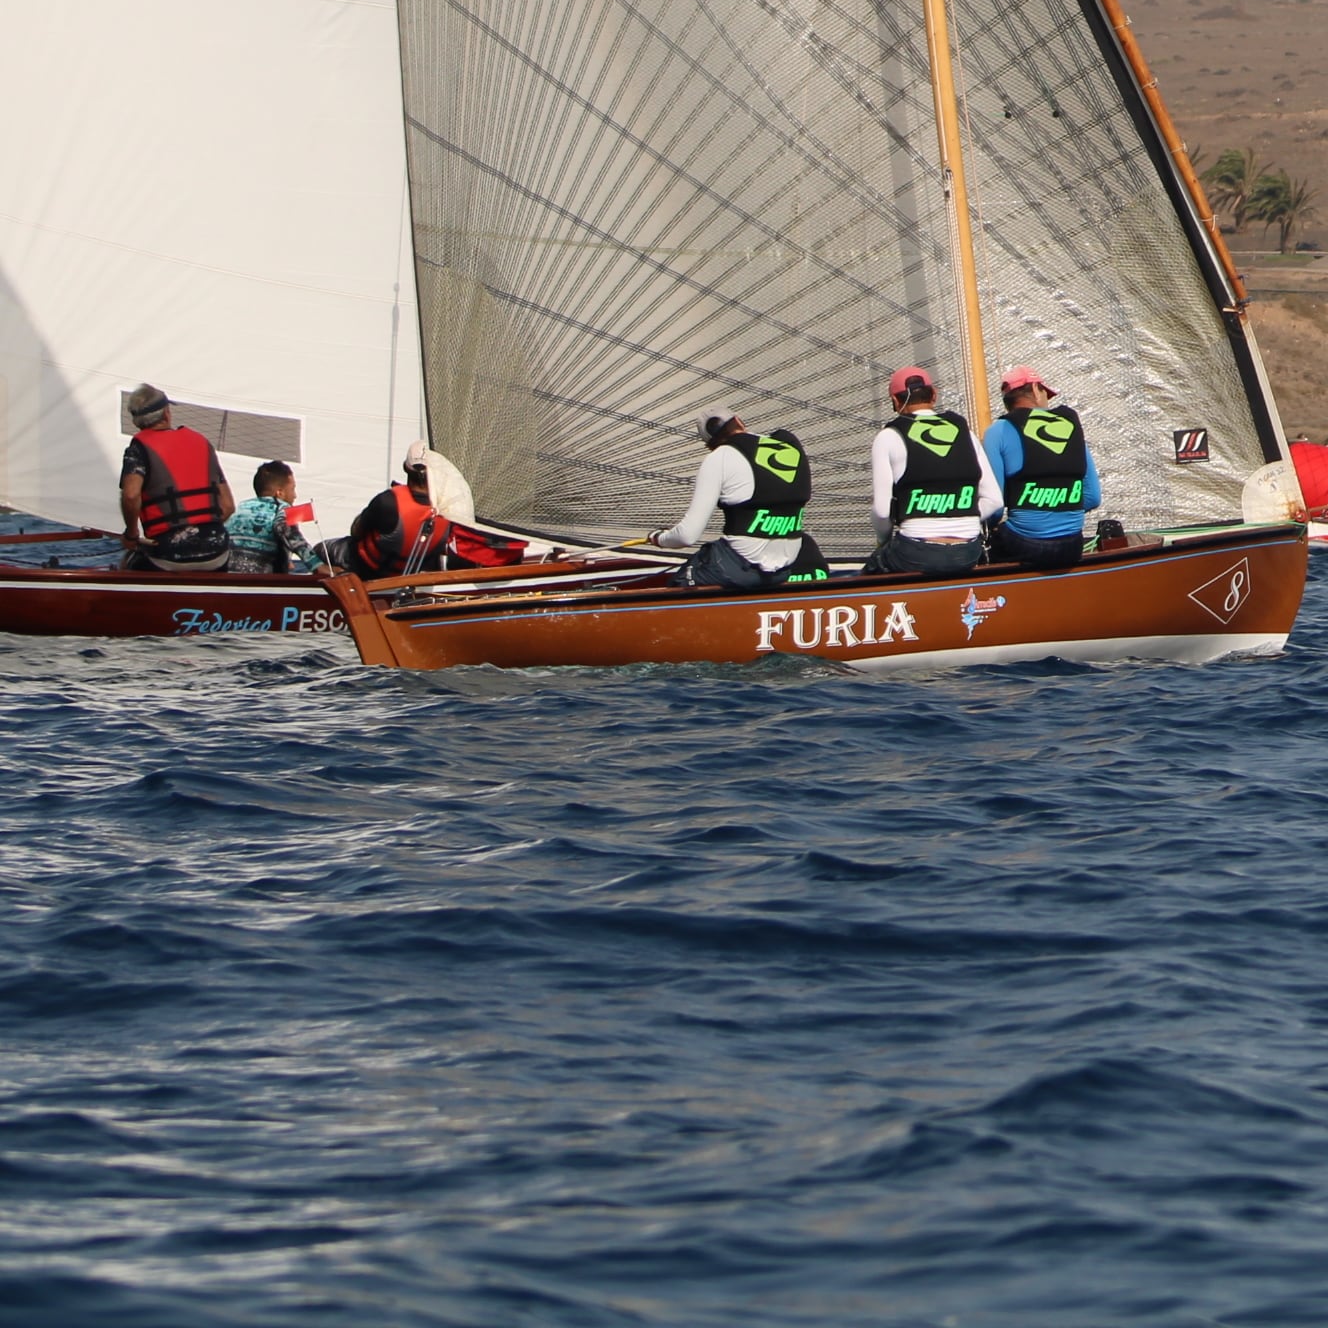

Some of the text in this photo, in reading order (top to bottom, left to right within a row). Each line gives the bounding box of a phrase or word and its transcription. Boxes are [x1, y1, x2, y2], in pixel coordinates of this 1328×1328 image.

[906, 488, 956, 515] FURIA
[1017, 482, 1068, 508] FURIA
[747, 508, 800, 536] FURIA
[1224, 571, 1244, 612] 8
[172, 606, 349, 634] Federico PESC
[755, 601, 920, 652] FURIA
